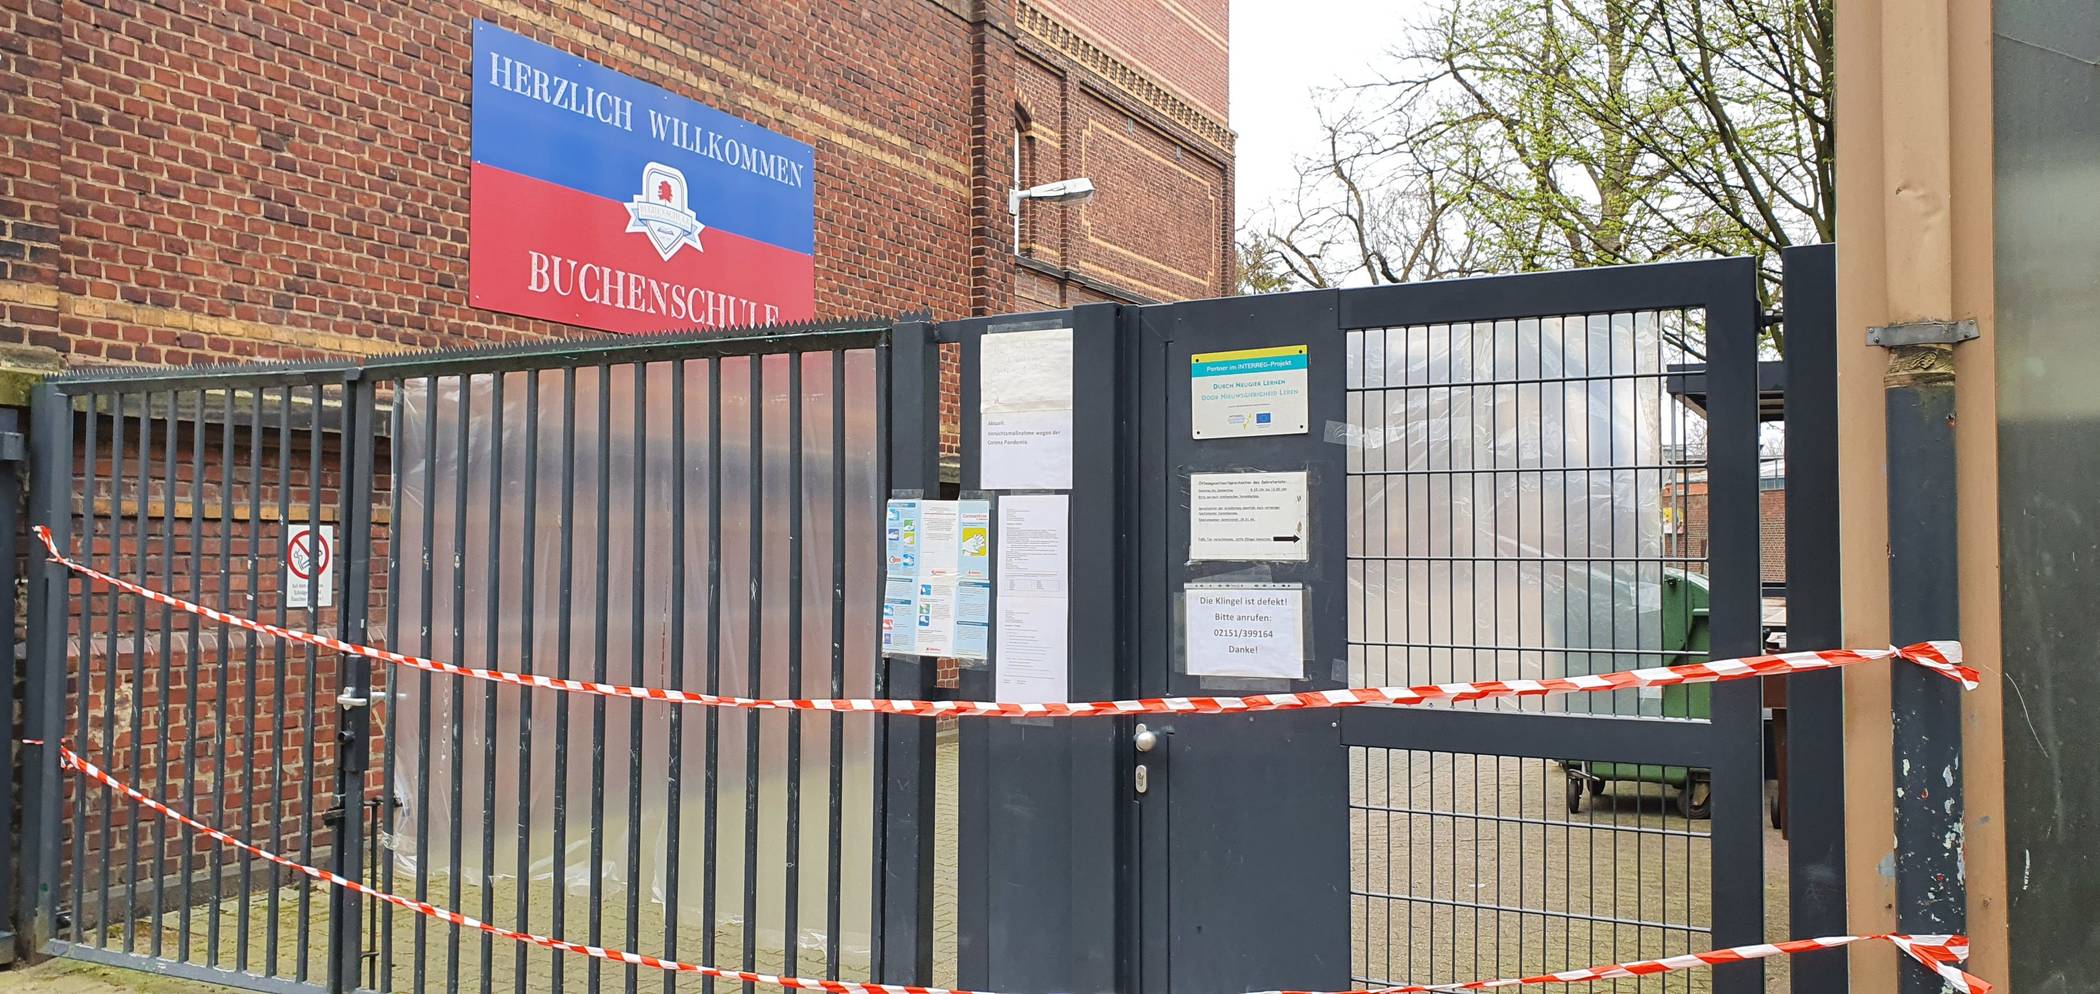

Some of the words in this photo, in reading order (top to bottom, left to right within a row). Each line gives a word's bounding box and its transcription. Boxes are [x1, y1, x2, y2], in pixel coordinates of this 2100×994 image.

[489, 51, 633, 131] HERZLICH
[648, 109, 804, 189] WILLKOMMEN
[528, 250, 779, 328] BUCHENSCHULE
[1206, 365, 1228, 373] Partner
[1237, 360, 1292, 370] INTERREG-Projekt
[1200, 596, 1213, 605] Die
[1215, 596, 1243, 607] Klingel
[1245, 597, 1255, 605] ist
[1257, 597, 1288, 606] defekt!
[1215, 613, 1234, 621] Bitte
[1236, 613, 1272, 622] anrufen:
[1213, 629, 1273, 638] 02151/399164
[1228, 645, 1258, 654] Danke!
